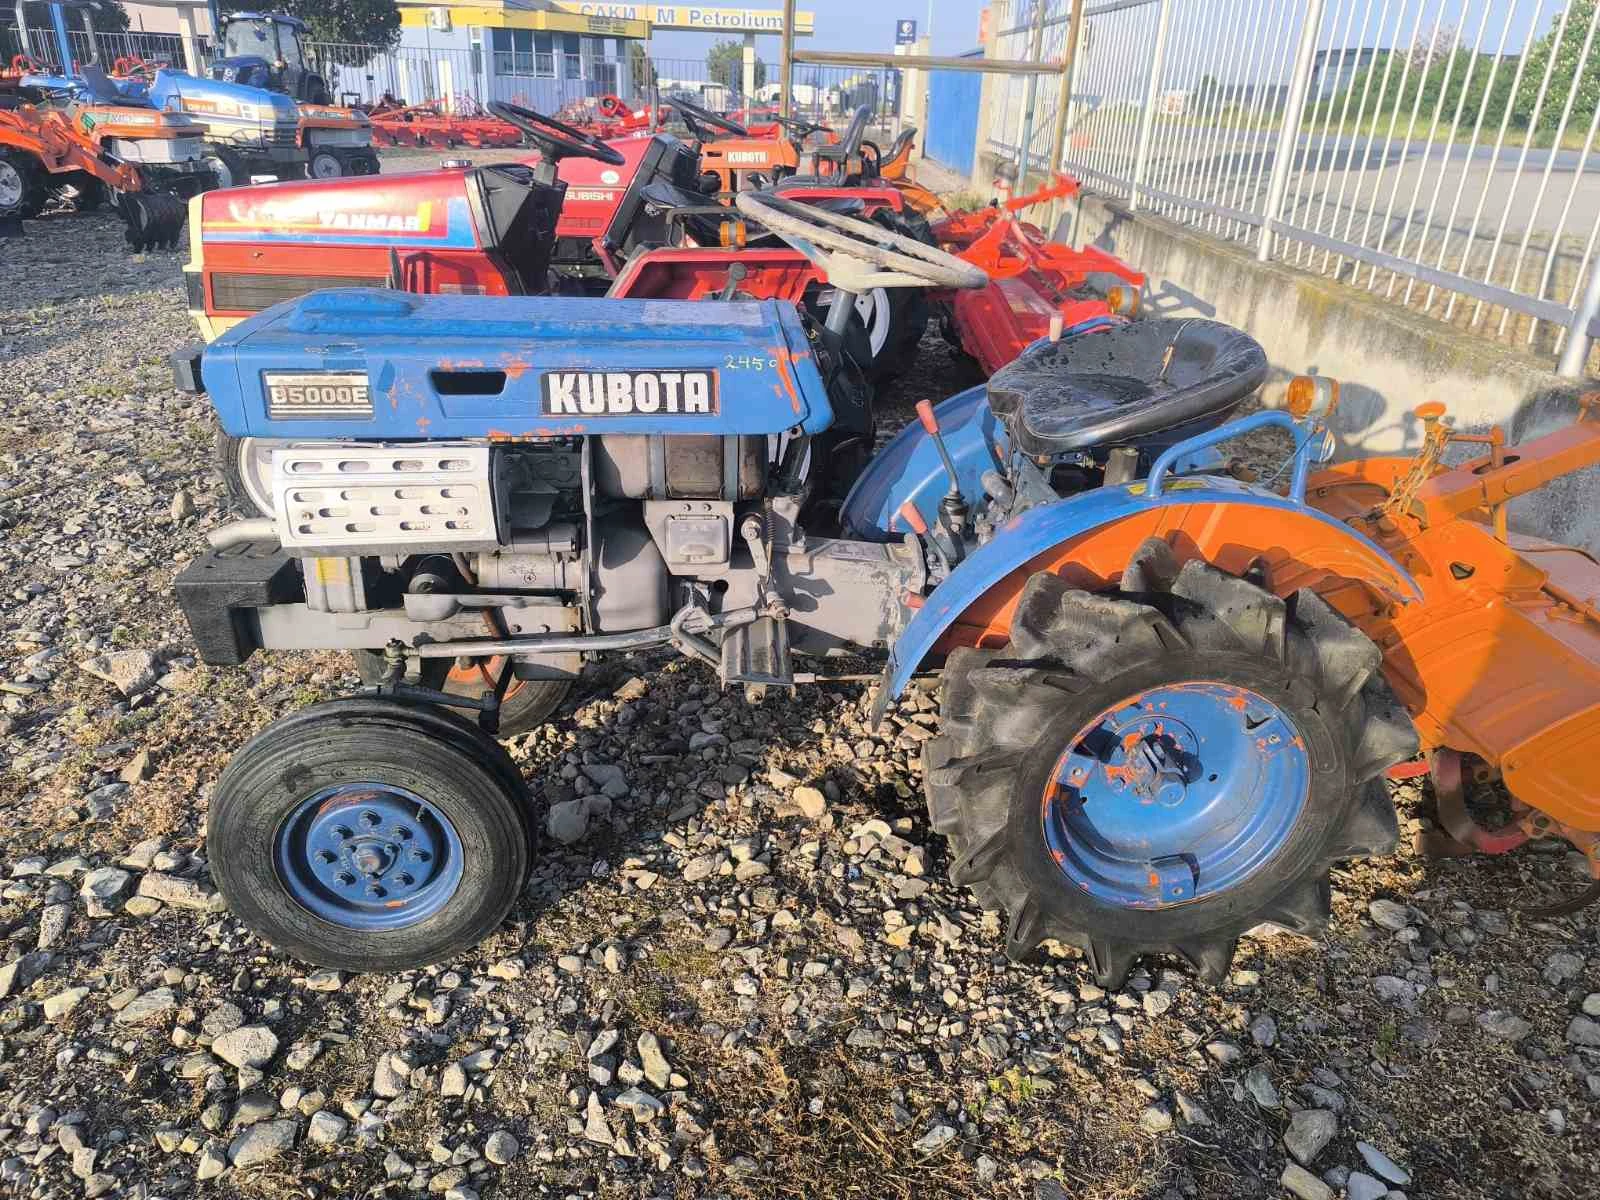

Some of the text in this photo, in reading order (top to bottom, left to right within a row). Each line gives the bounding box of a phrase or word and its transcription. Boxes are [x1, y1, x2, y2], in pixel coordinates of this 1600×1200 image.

[727, 152, 767, 164] KUBOTA
[564, 191, 613, 201] SUBISHI
[320, 209, 419, 232] YANMAR
[548, 373, 710, 413] KUBOTA
